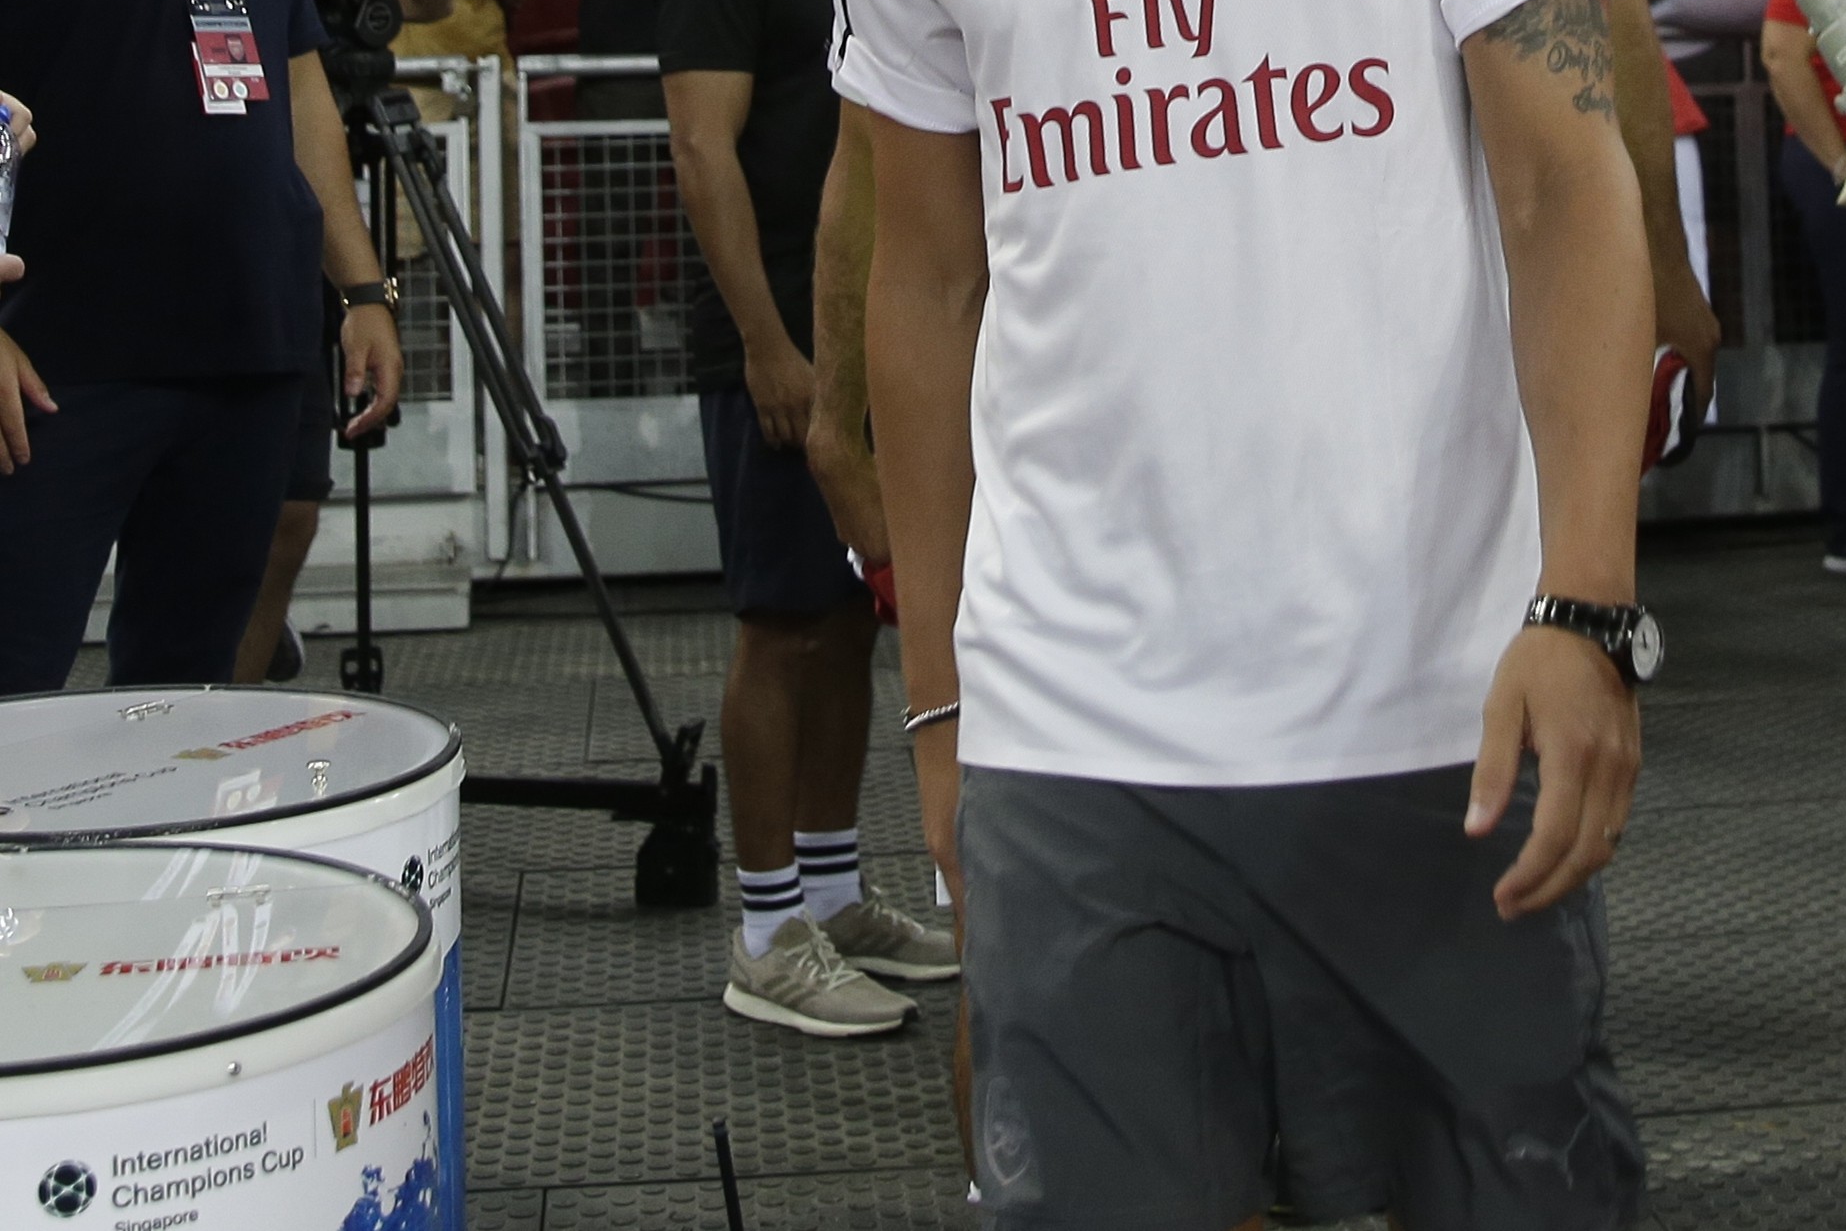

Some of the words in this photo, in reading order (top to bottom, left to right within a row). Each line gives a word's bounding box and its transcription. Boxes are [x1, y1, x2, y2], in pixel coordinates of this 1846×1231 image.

[989, 53, 1396, 194] Emirates
[111, 1160, 256, 1209] Champions
[261, 1144, 305, 1174] Cup
[112, 1120, 268, 1178] International
[114, 1208, 199, 1231] Singapore
